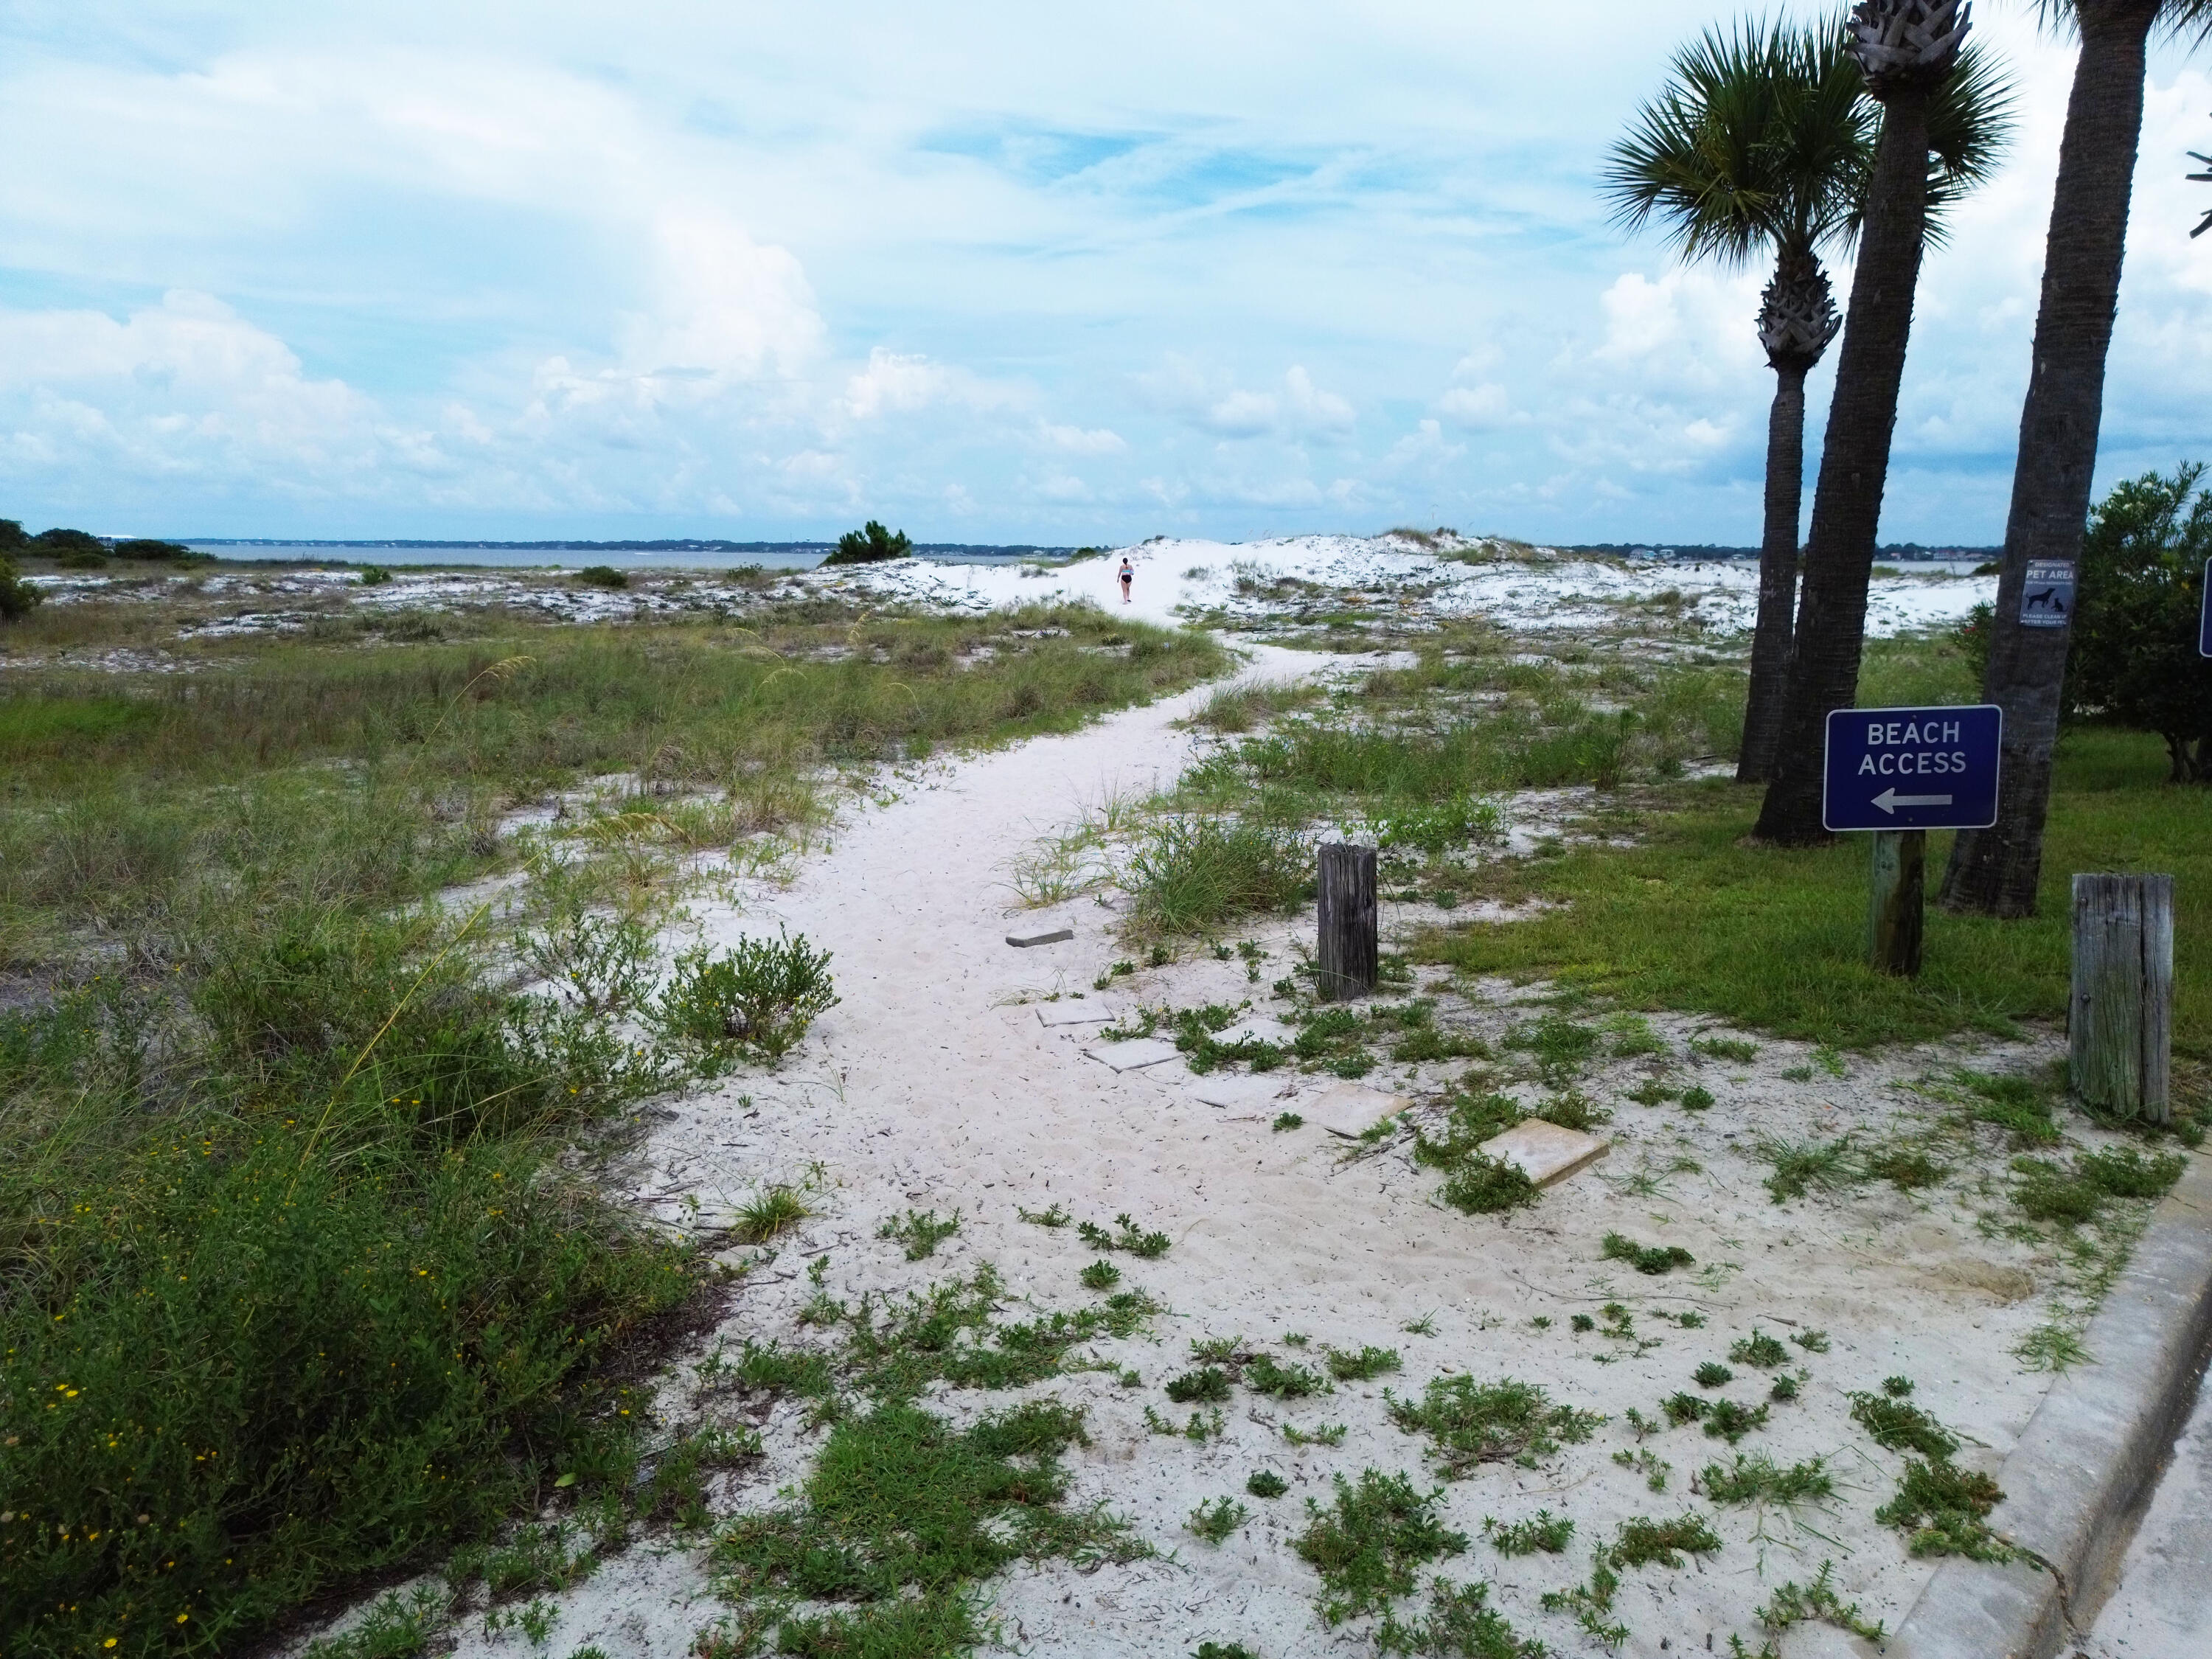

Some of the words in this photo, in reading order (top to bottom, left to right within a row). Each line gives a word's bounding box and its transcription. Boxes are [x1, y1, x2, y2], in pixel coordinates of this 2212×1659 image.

[2026, 570, 2047, 579] PET
[2048, 570, 2073, 579] AREA
[1868, 721, 1960, 745] BEACH
[1857, 751, 1966, 775] ACCESS
